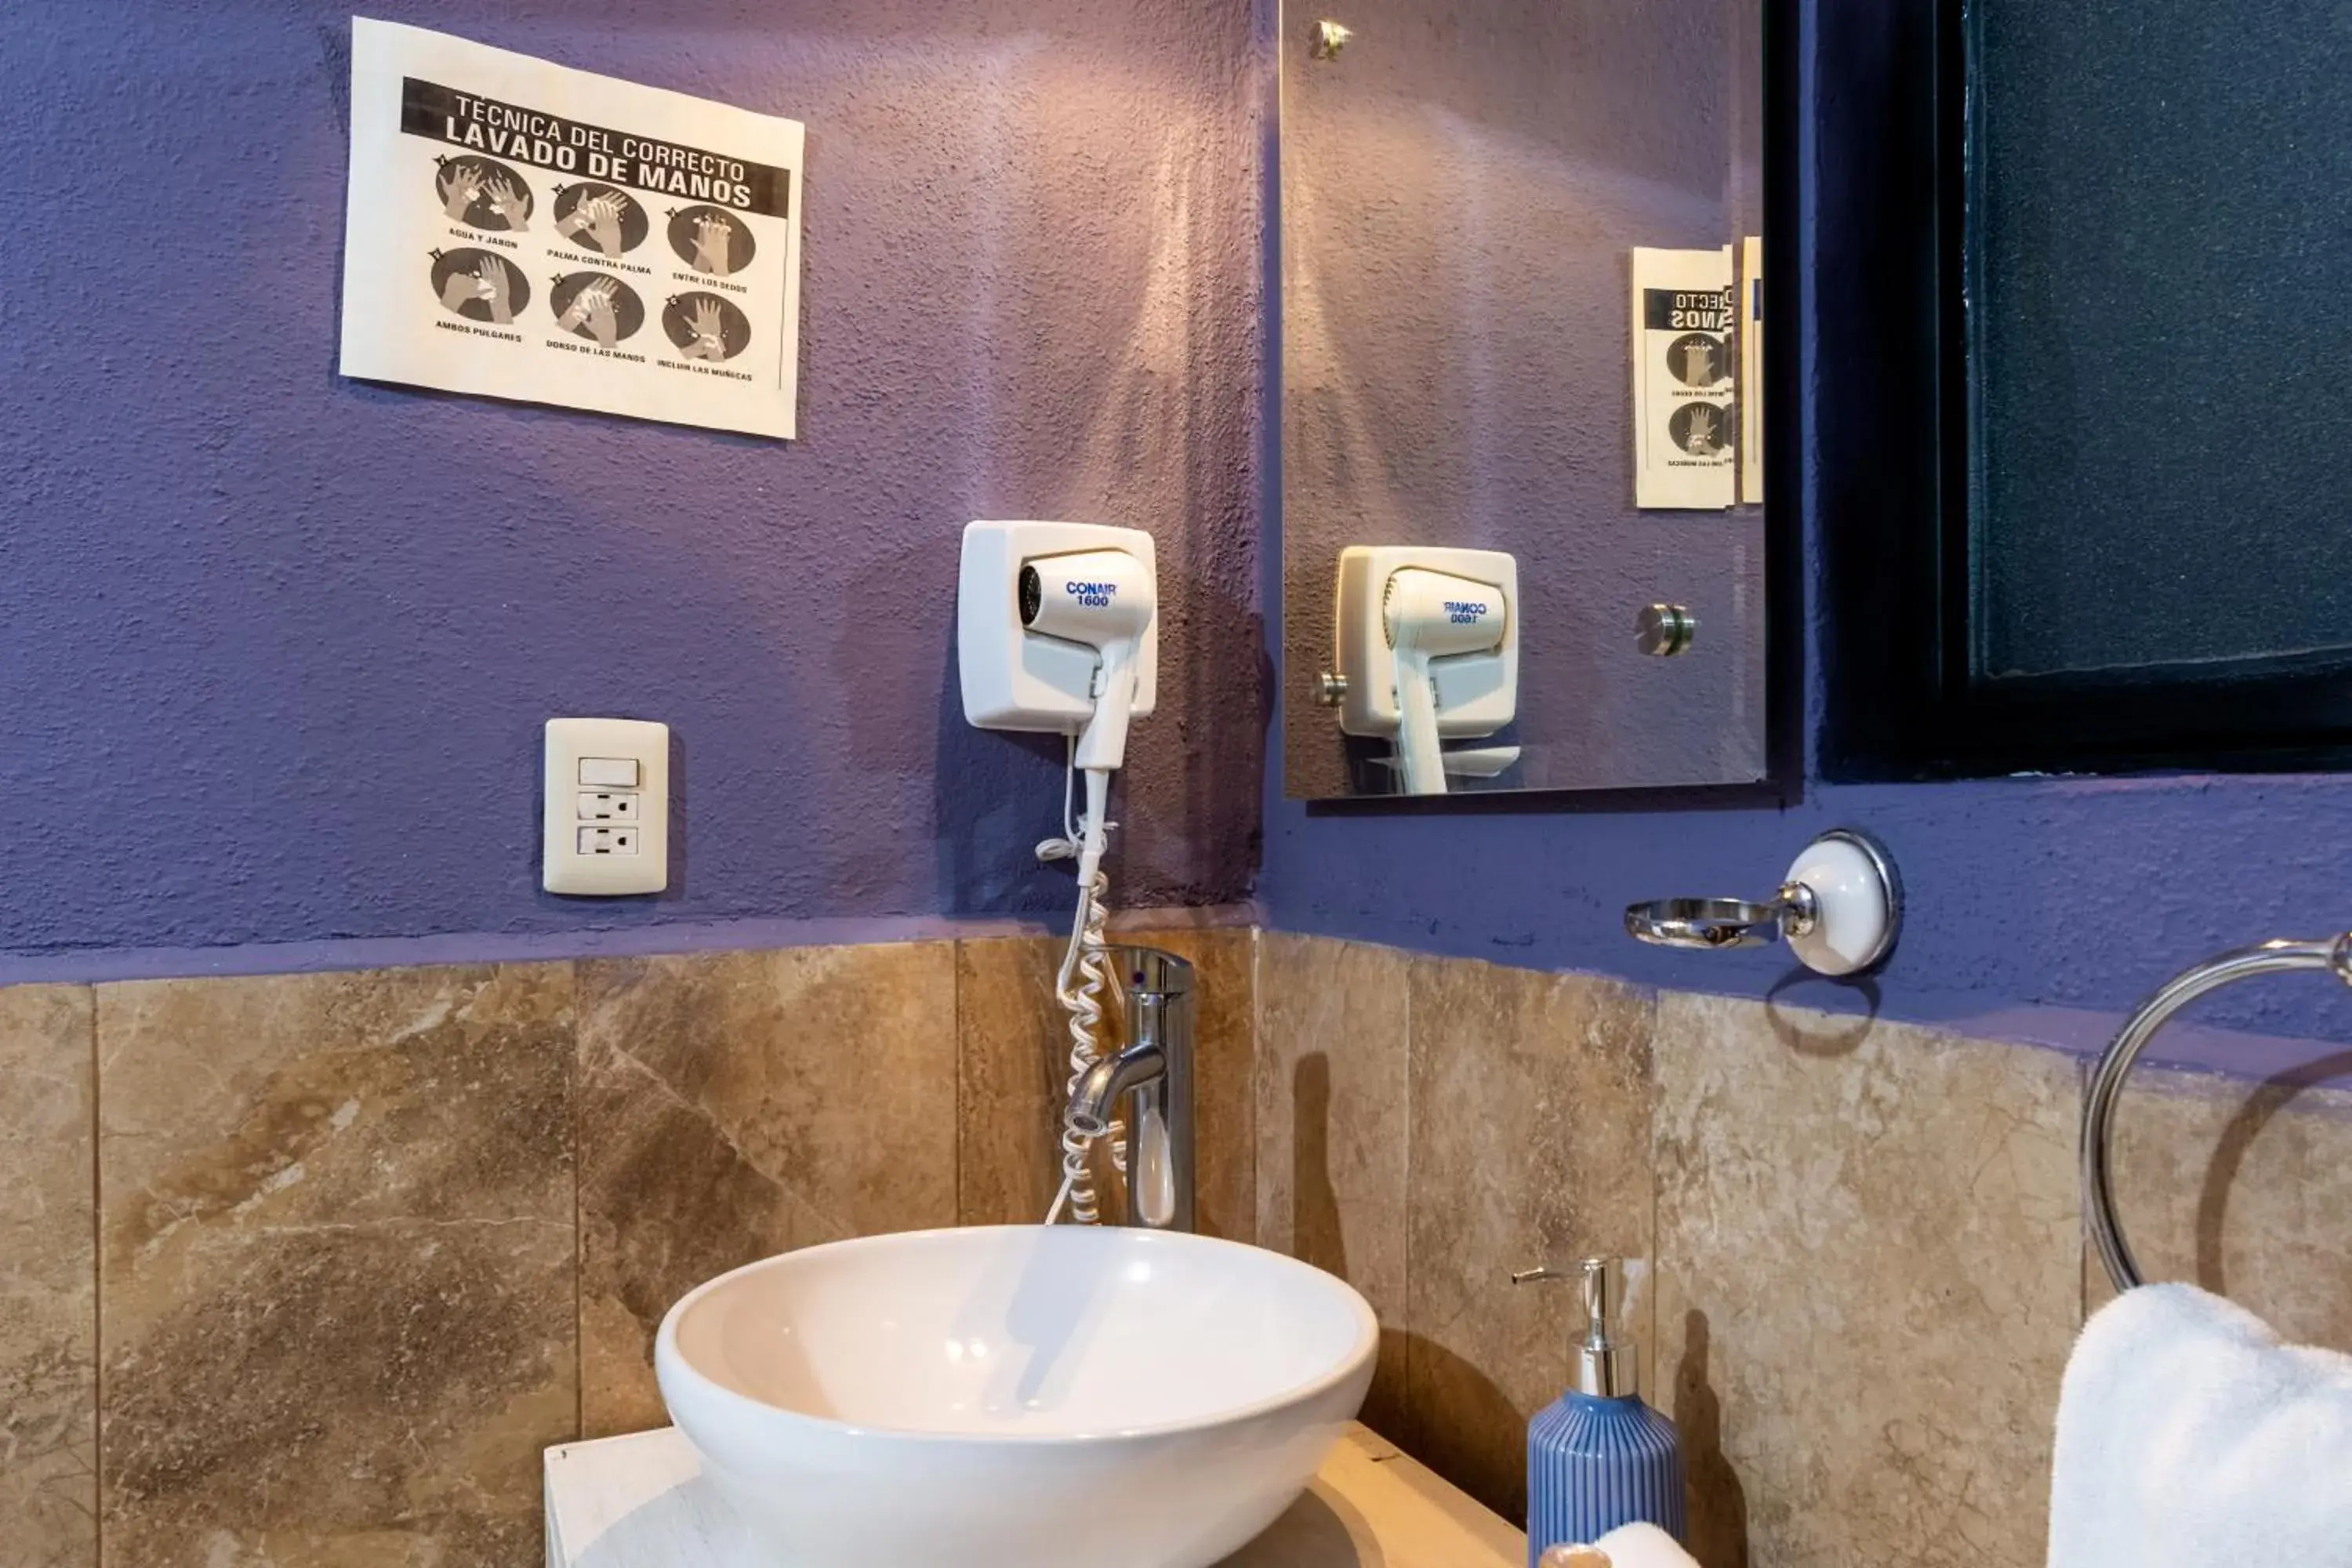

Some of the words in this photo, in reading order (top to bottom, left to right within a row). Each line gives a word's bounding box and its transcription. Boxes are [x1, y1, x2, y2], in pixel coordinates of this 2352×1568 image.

[571, 126, 614, 154] DEL
[622, 139, 744, 182] CORRECTO
[446, 117, 576, 170] LAVADO
[589, 153, 627, 182] DE
[639, 163, 750, 208] MANOS
[449, 227, 474, 240] AGUA
[546, 249, 579, 262] PALMA
[581, 256, 618, 269] CONTRA
[620, 263, 652, 275] PALMA
[672, 272, 699, 283] ENTRE
[702, 278, 718, 288] LOS
[436, 321, 471, 334] AMBOS
[546, 339, 578, 352] DORSO
[593, 348, 610, 358] LAS
[613, 351, 646, 363] MANOS
[1066, 581, 1116, 596] CONAIR
[1078, 595, 1109, 606] 1600
